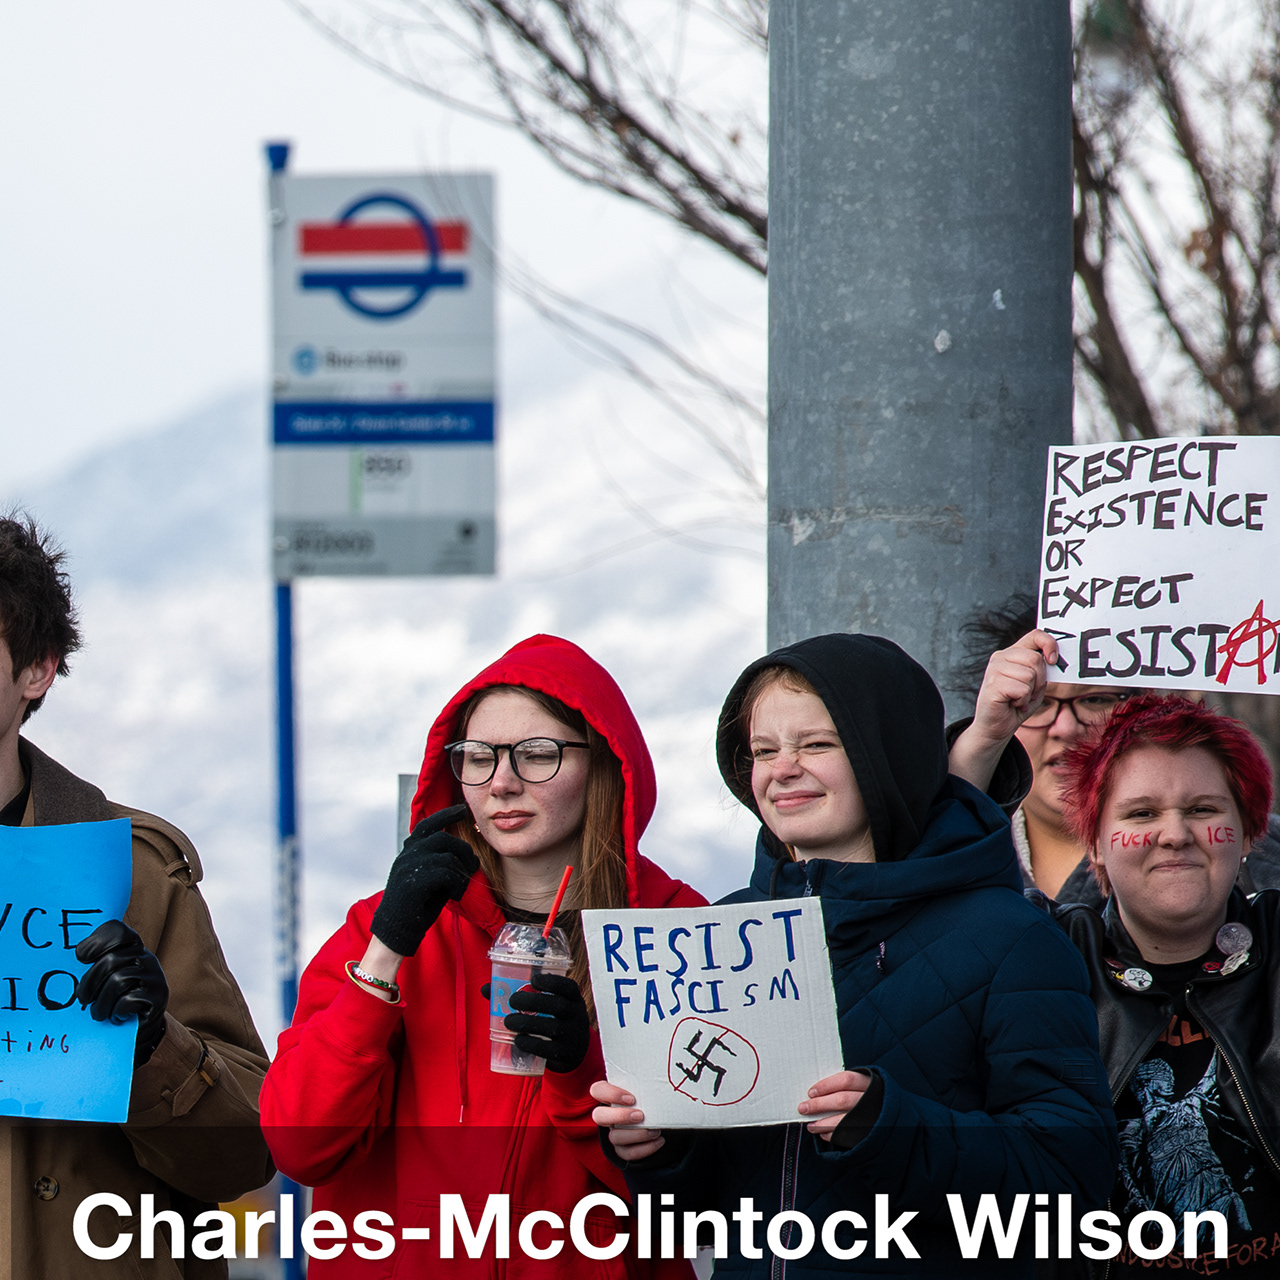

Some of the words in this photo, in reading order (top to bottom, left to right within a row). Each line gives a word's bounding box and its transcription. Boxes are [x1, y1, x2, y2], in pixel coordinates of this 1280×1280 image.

[1053, 441, 1238, 497] RESPECT
[1046, 488, 1268, 536] EXISTENCE
[1045, 538, 1086, 571] OR
[1041, 573, 1194, 619] EXPECT
[1043, 599, 1280, 686] RESISTA
[1110, 831, 1153, 851] FUCK
[1207, 826, 1236, 846] ICE
[602, 908, 802, 977] RESIST
